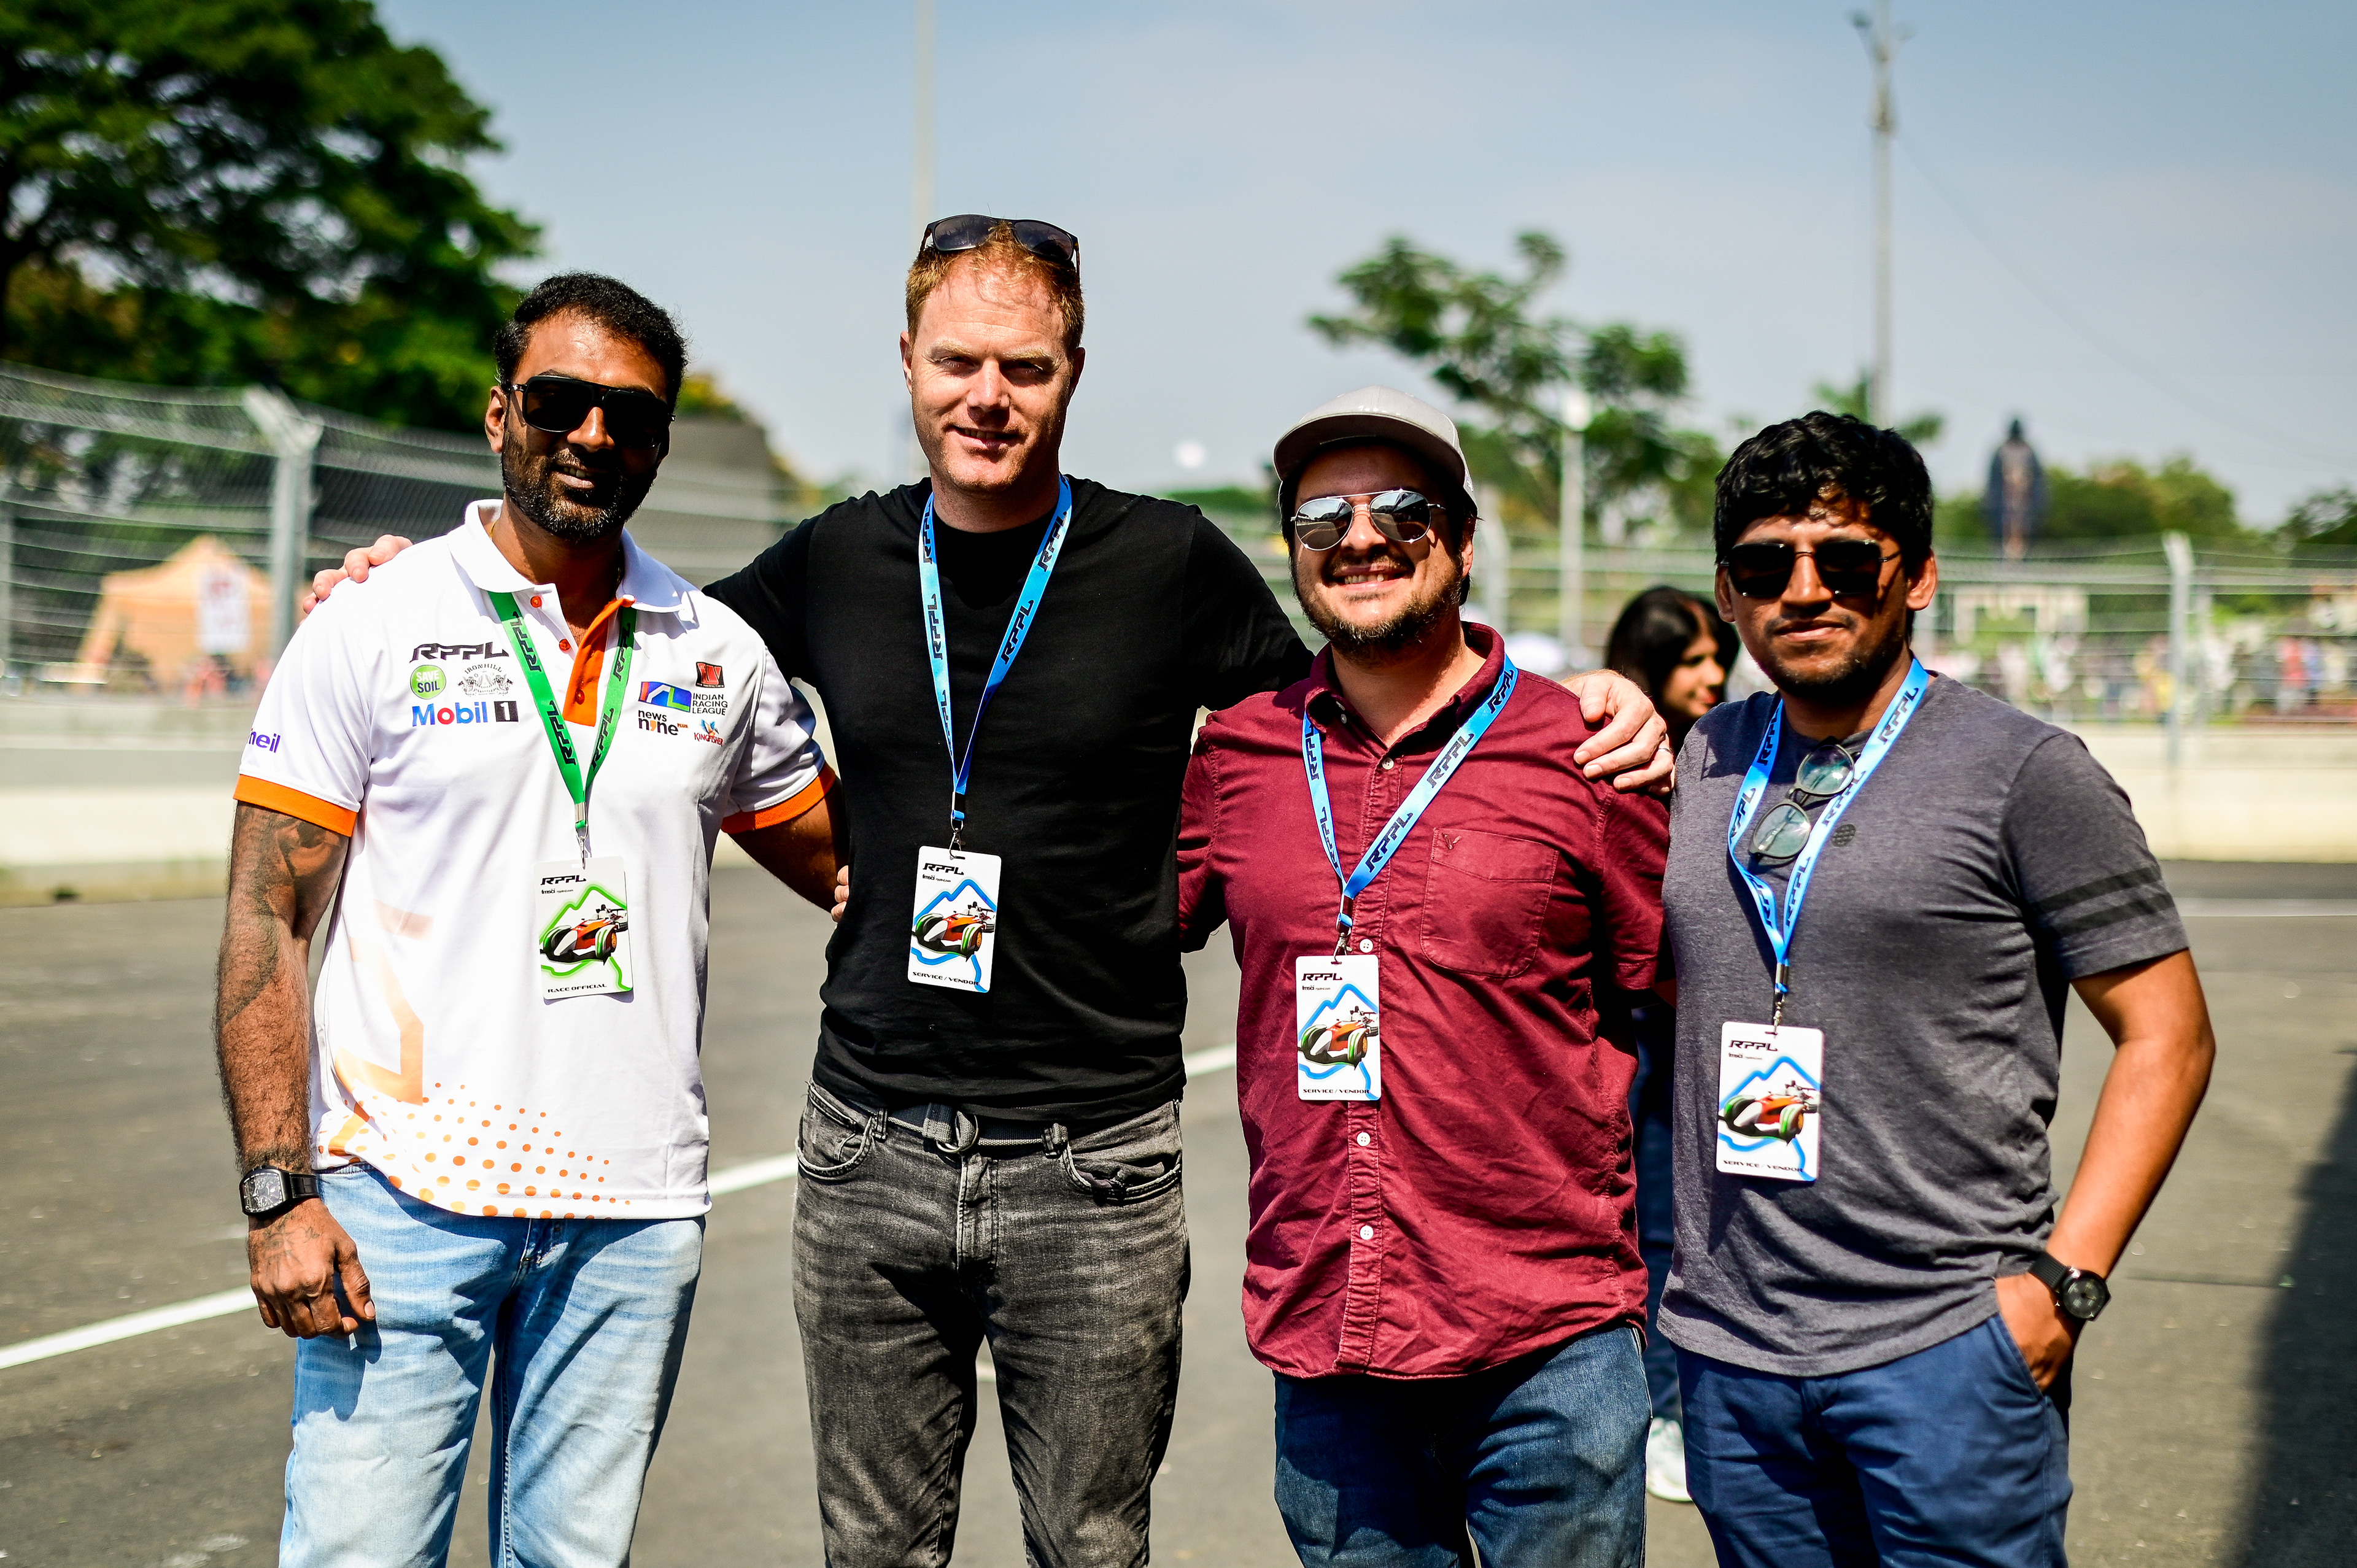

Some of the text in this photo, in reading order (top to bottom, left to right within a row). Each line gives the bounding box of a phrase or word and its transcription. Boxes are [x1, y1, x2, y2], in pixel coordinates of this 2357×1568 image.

[1038, 511, 1067, 572] RPPL
[511, 611, 542, 672] RPPL
[927, 593, 943, 660] RPPL
[1000, 599, 1034, 665] RPPL
[409, 641, 509, 663] RPPL
[613, 622, 630, 681] RPPL
[416, 670, 440, 682] SAVE
[417, 681, 441, 693] SOIL
[1487, 670, 1514, 714] RPPL
[412, 701, 488, 727] Mobil
[547, 700, 576, 765] RPPL
[638, 710, 667, 722] news
[1878, 687, 1919, 744] RPPL
[591, 708, 614, 771] RPPL
[694, 732, 724, 747] KINGFISHER
[1426, 733, 1474, 789] RPPL
[1365, 813, 1413, 873] RPPL
[540, 875, 587, 886] RPPL
[923, 863, 964, 875] RPPL
[913, 971, 943, 980] SERVICE
[948, 977, 980, 986] VENDOR
[1728, 1040, 1778, 1051] RPPL
